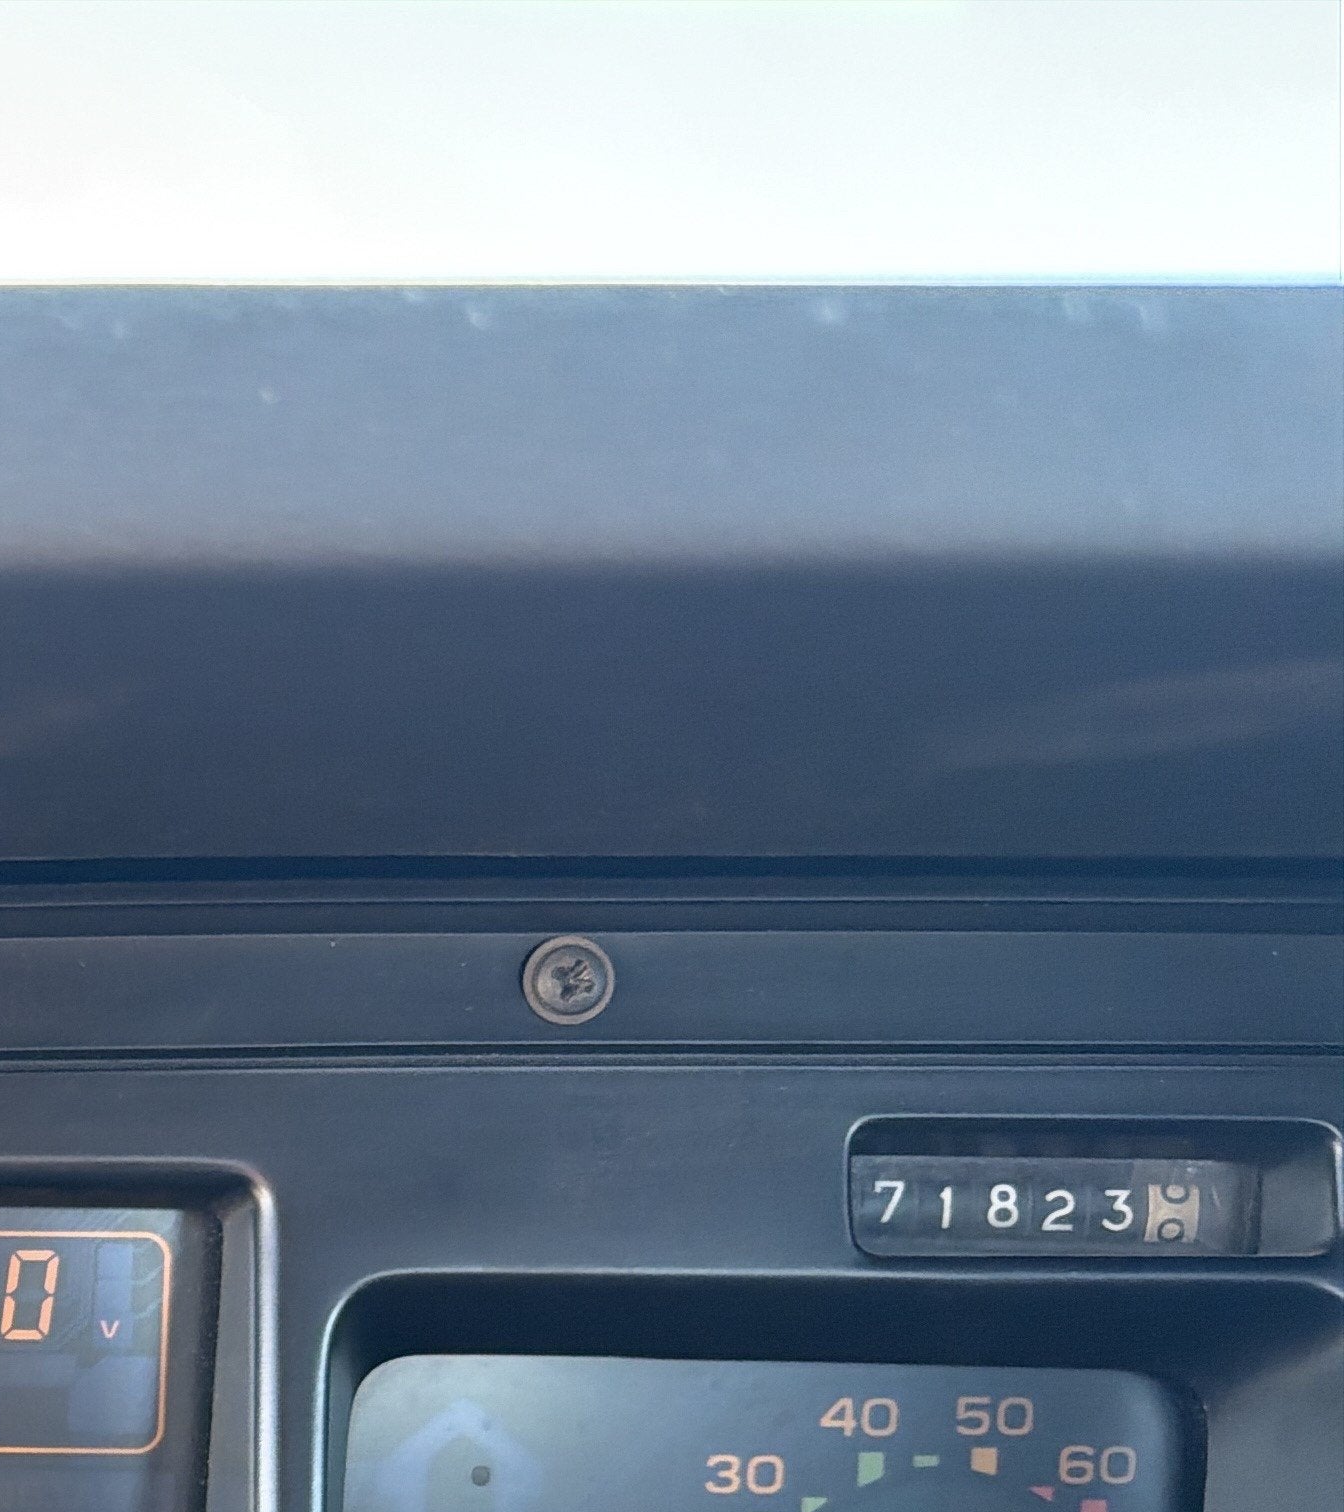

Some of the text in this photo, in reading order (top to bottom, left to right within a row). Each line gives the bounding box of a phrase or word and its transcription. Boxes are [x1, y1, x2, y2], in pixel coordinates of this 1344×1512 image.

[819, 1397, 898, 1437] 40
[957, 1396, 1033, 1436] 50
[705, 1454, 784, 1494] 30
[1057, 1445, 1138, 1486] 60
